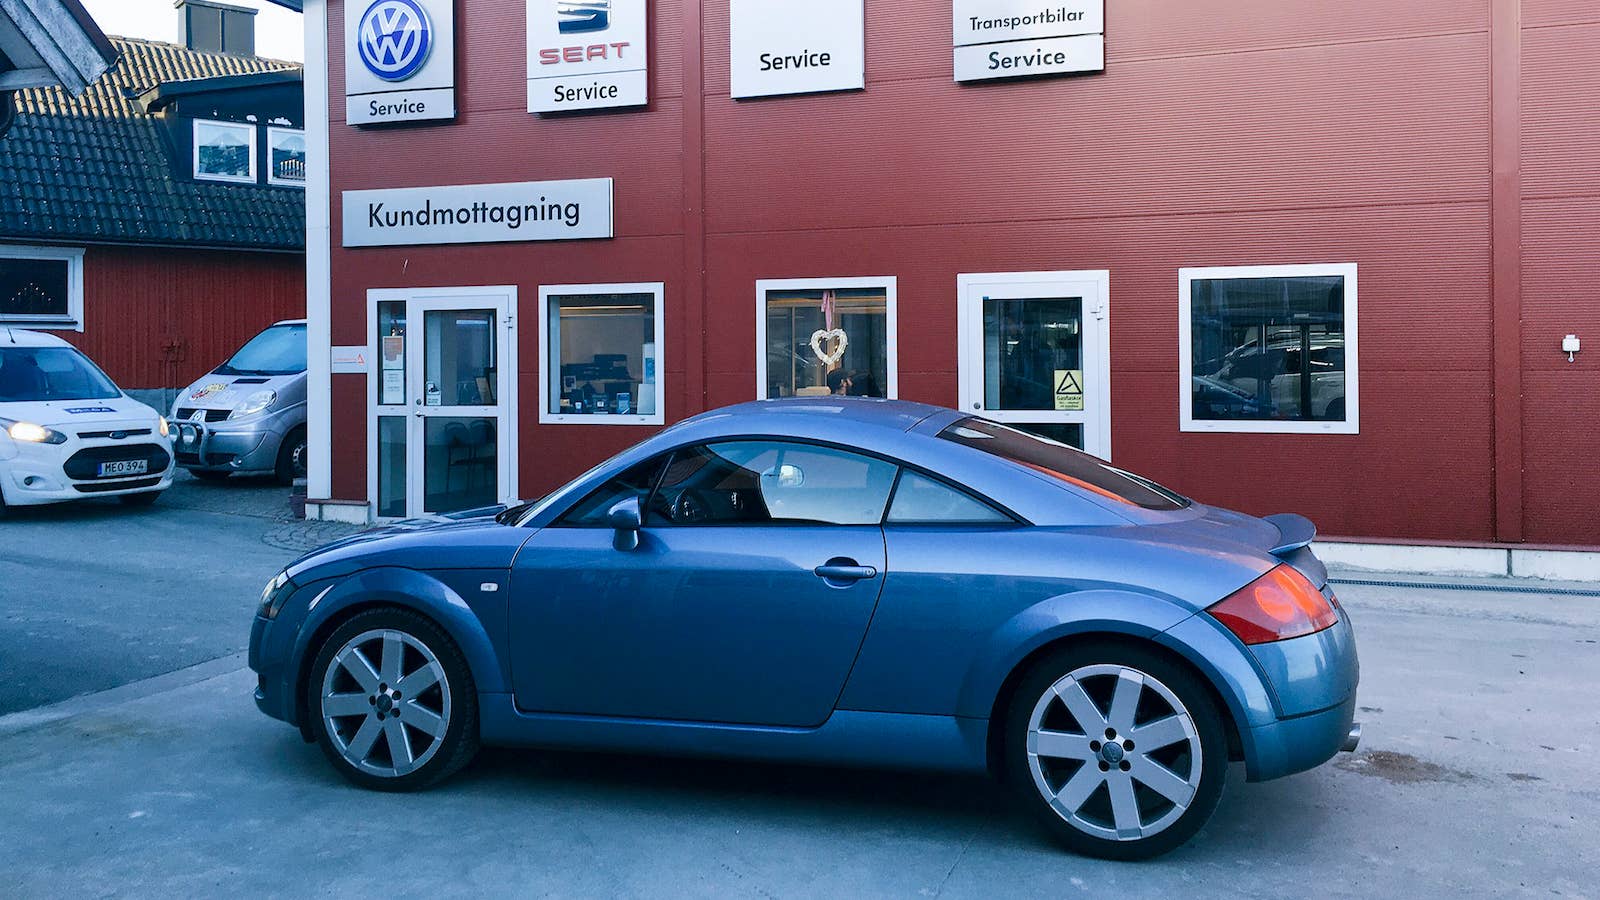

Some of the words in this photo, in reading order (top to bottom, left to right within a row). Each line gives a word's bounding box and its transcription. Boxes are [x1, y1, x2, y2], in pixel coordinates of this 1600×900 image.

[969, 7, 1085, 31] Transportbilar
[539, 42, 630, 65] SEAT
[760, 49, 831, 71] Service
[988, 48, 1066, 70] Service
[554, 81, 618, 102] Service
[369, 98, 425, 116] Service
[369, 196, 580, 229] Kundmottagning
[104, 461, 124, 473] MEO
[126, 460, 144, 471] 394
